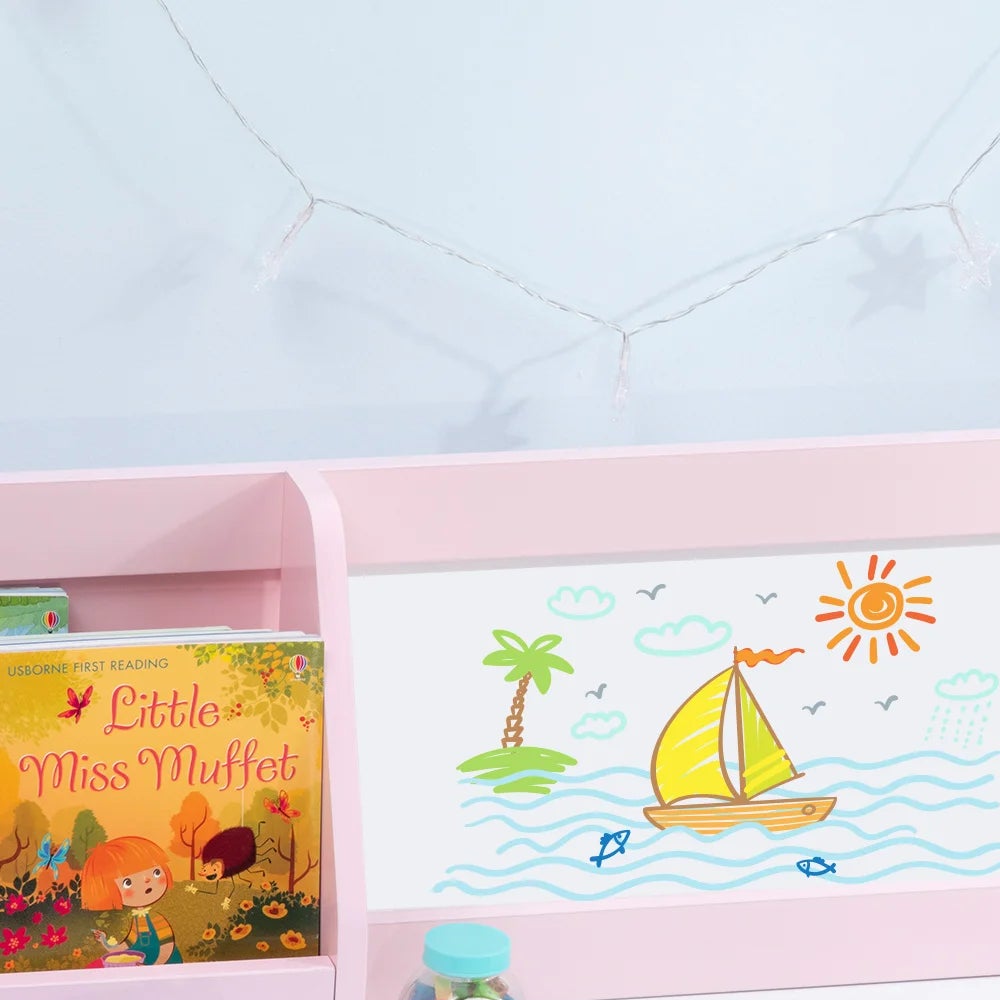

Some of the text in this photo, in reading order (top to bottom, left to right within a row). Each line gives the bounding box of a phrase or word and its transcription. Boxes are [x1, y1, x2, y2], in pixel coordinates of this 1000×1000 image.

[7, 658, 169, 677] USBORNE FIRST READING
[103, 682, 220, 735] Little
[19, 737, 299, 798] Miss Muffet
